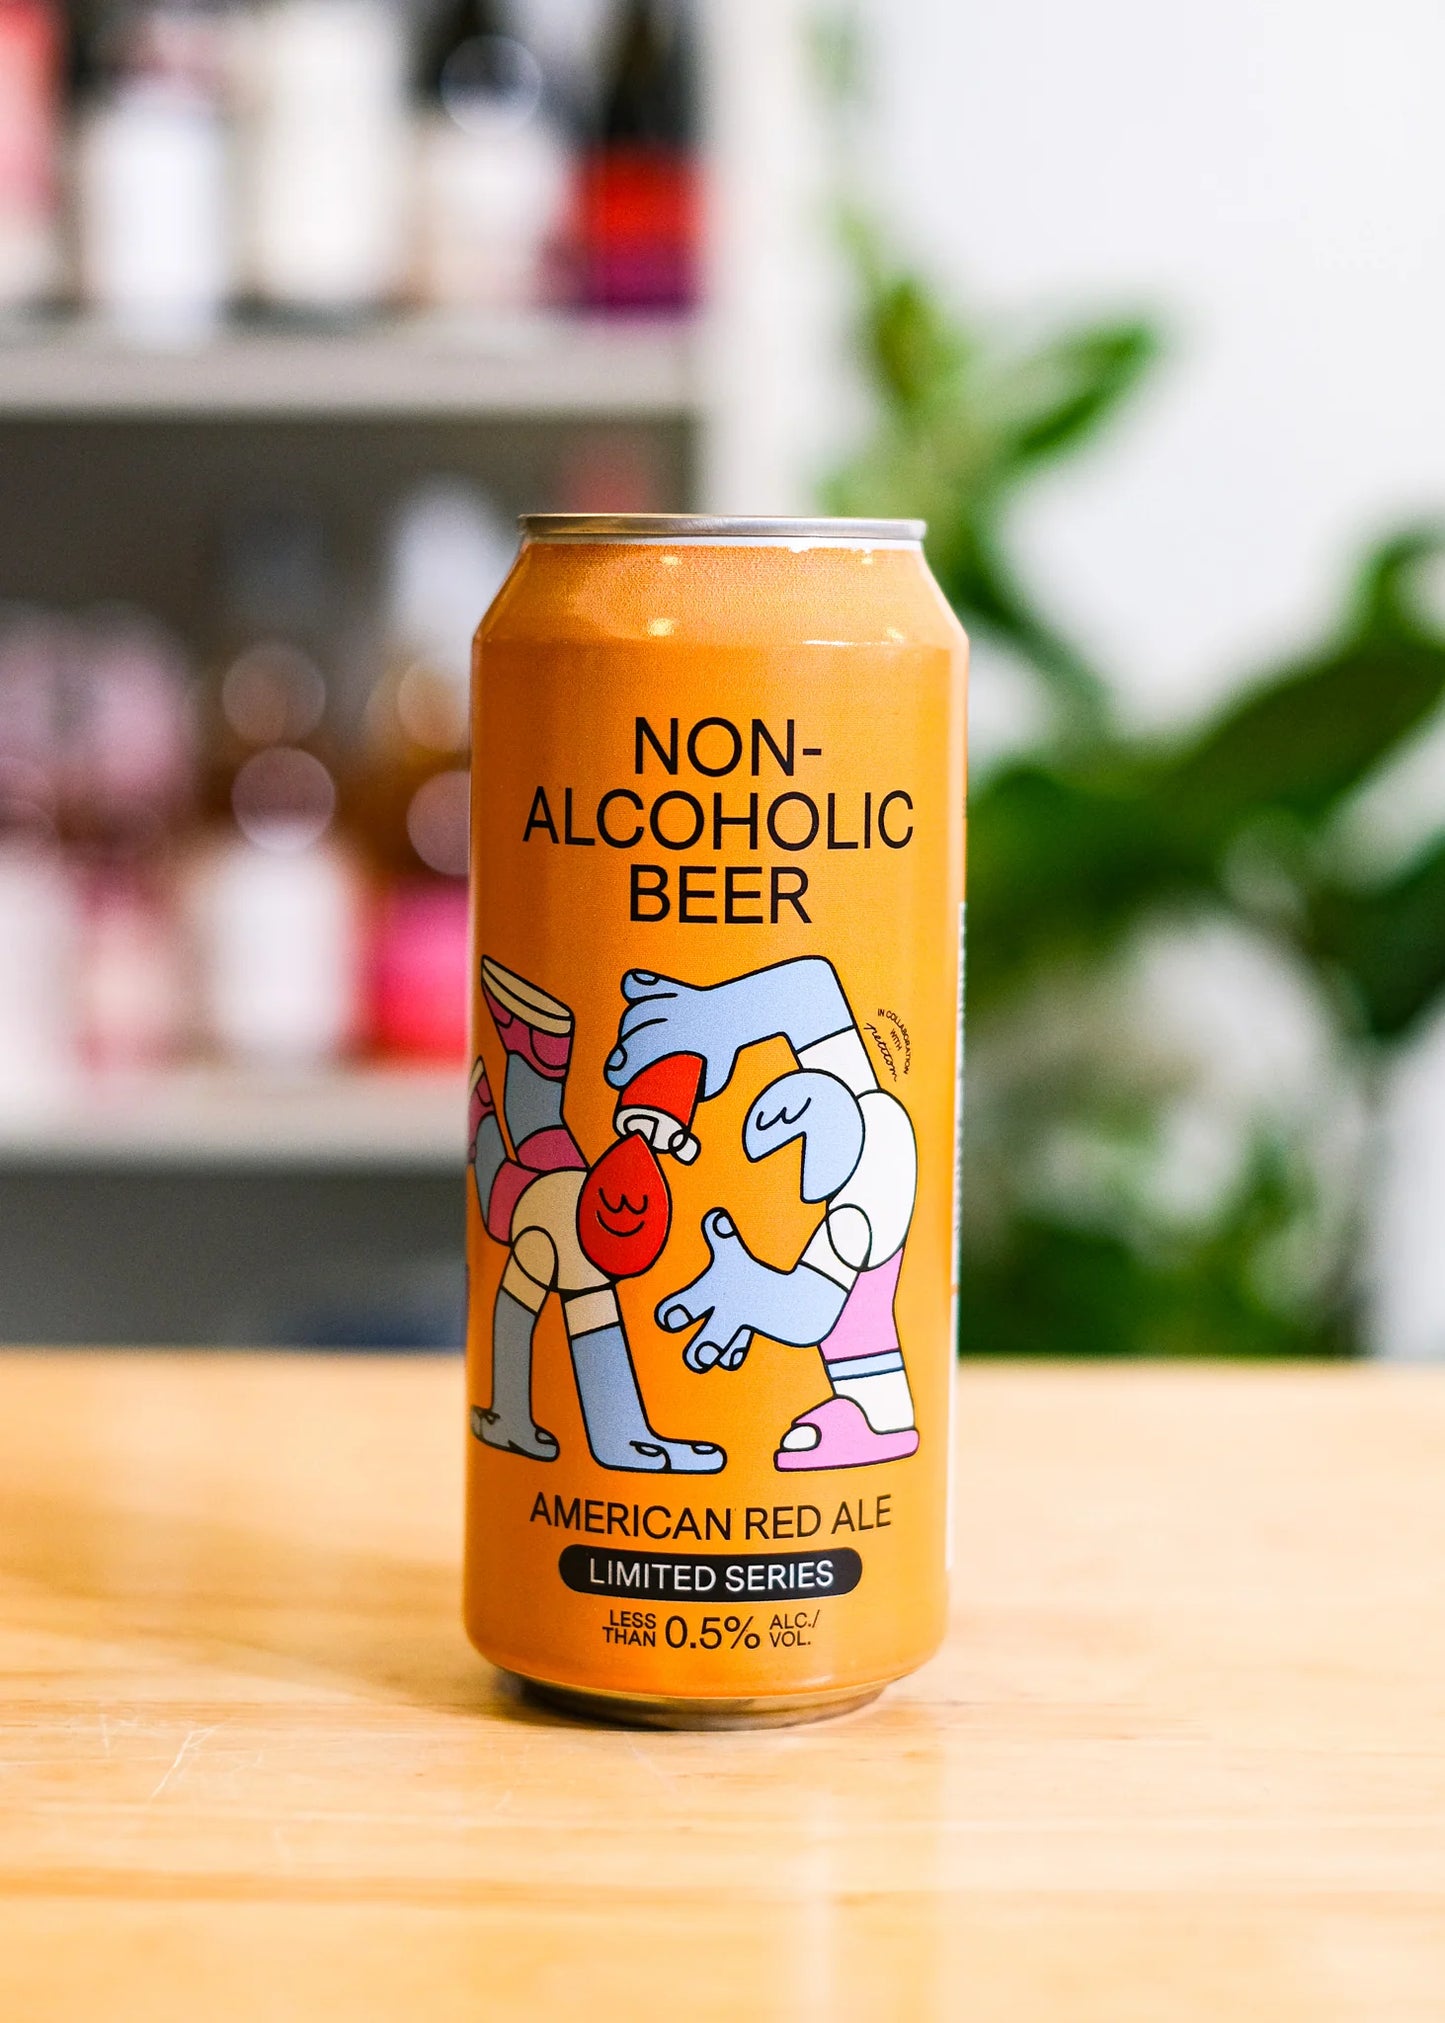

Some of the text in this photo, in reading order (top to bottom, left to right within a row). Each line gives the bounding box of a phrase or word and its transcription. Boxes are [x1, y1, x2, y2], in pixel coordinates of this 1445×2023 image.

[634, 717, 822, 777] NON-
[522, 786, 914, 851] ALCOHOLIC
[630, 864, 812, 924] BEER
[877, 1008, 911, 1074] IN COLLABORATION
[890, 1028, 902, 1051] WITH
[529, 1492, 892, 1540] AMERICAN RED ALE
[589, 1558, 834, 1591] LIMITED SERIES
[609, 1609, 657, 1629] LESS
[664, 1615, 761, 1650] 0.5%
[769, 1609, 820, 1631] ALC./
[602, 1626, 657, 1648] THAN
[769, 1630, 812, 1648] VOL.
